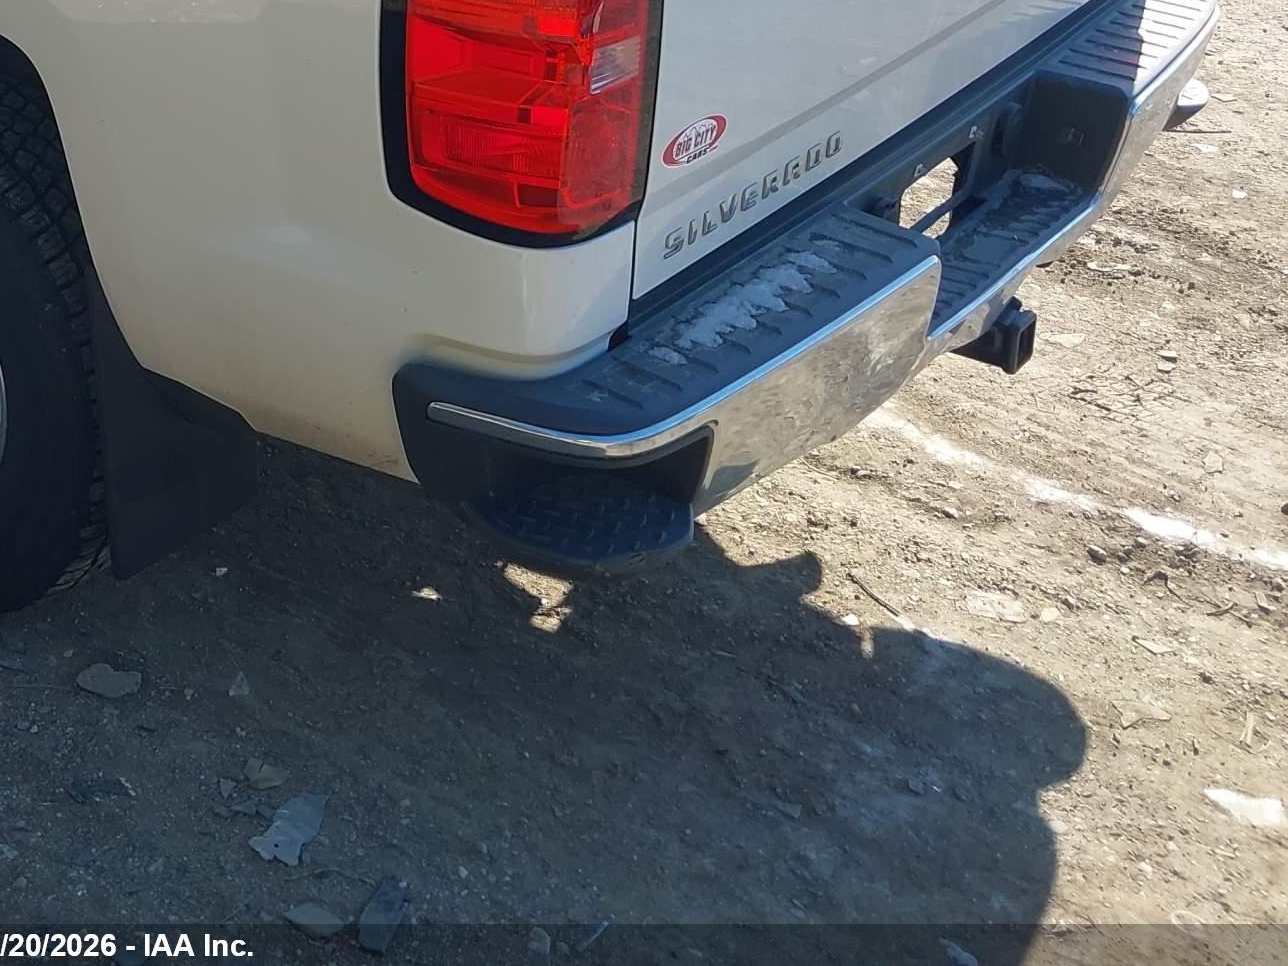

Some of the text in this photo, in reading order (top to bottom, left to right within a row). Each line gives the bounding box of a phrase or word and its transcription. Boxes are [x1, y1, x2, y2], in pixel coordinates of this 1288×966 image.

[674, 124, 717, 158] BIG CITY
[686, 147, 709, 164] CARS
[663, 130, 843, 260] SILVERADO
